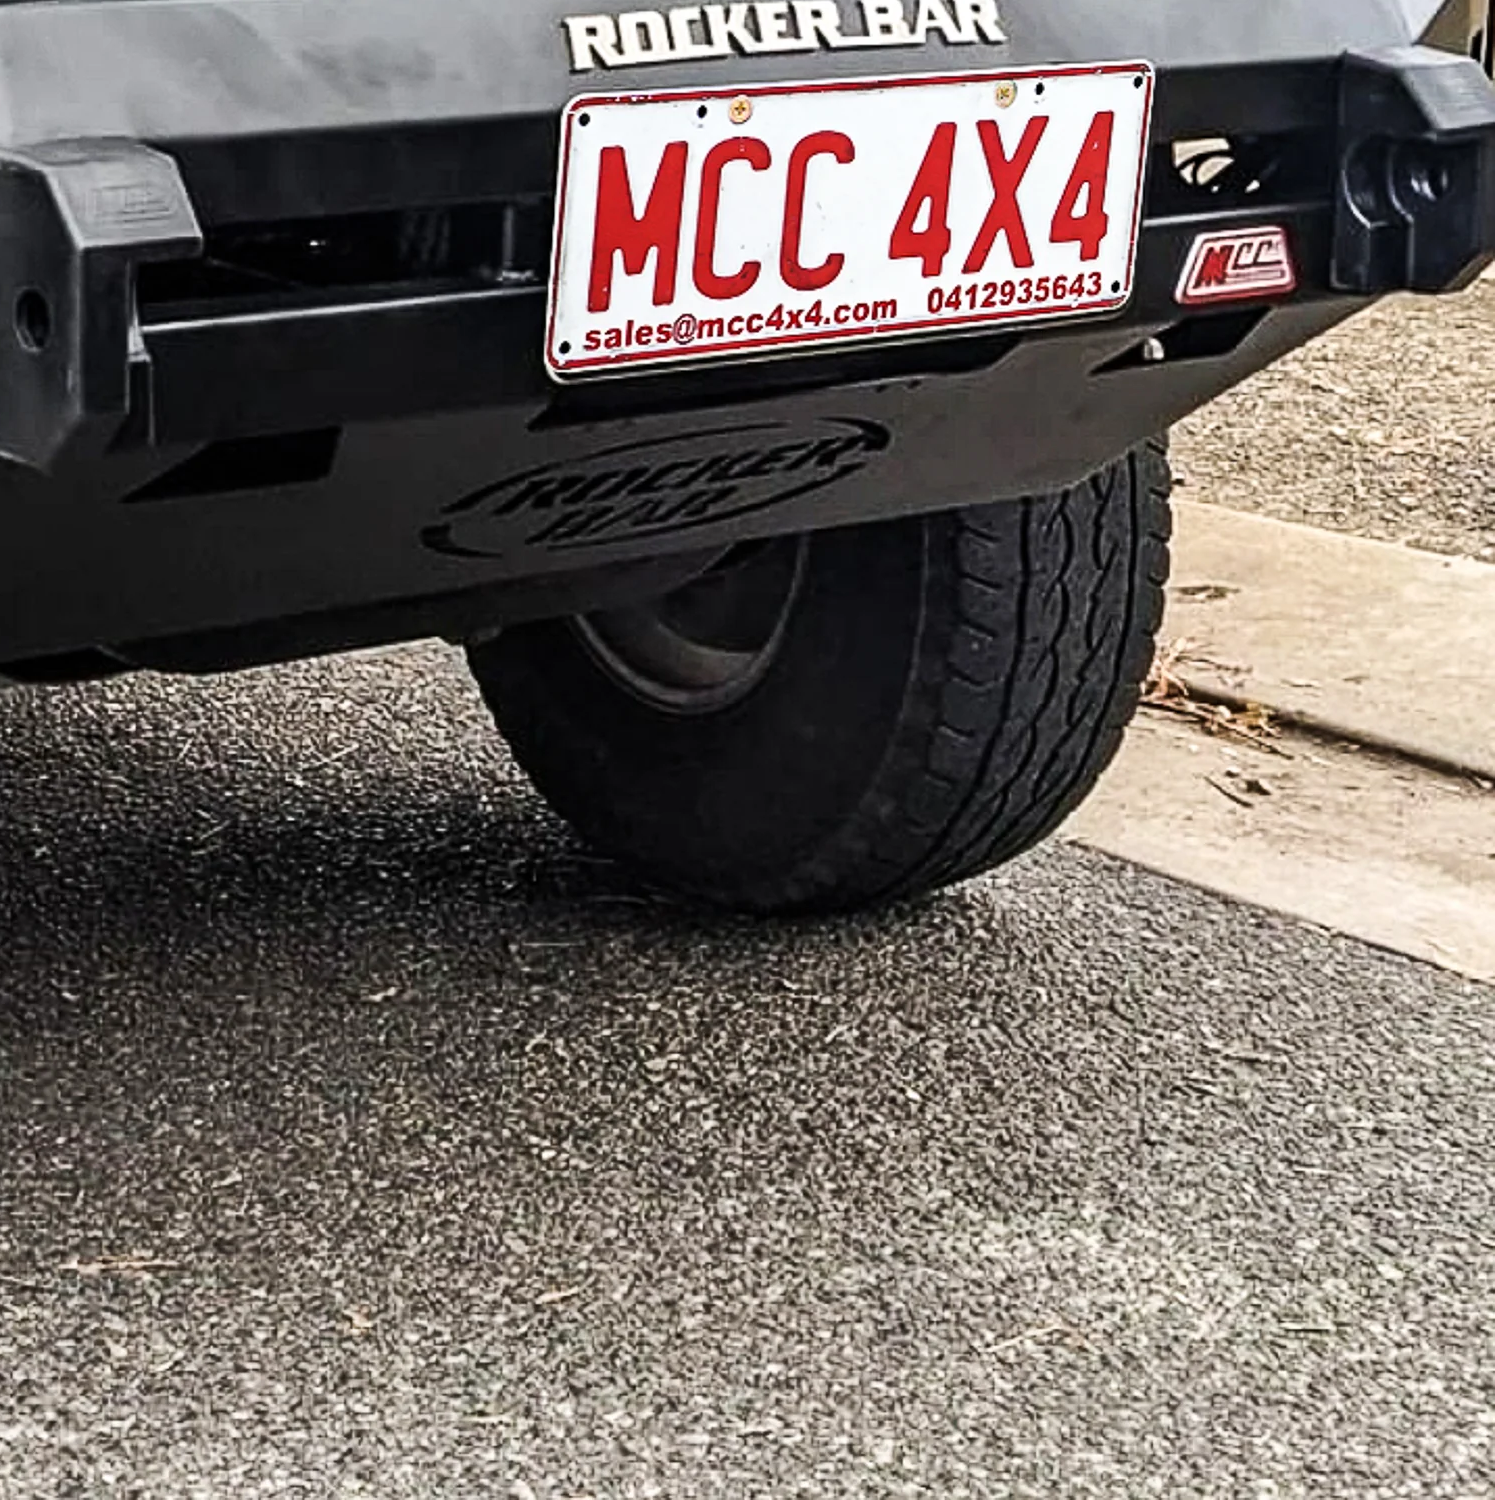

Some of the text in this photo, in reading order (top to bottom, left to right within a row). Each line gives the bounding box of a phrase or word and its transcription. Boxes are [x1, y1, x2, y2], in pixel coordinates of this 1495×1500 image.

[587, 110, 1114, 314] MCC 4X4
[583, 271, 1103, 352] sales@mcc4x4.com 0412935643
